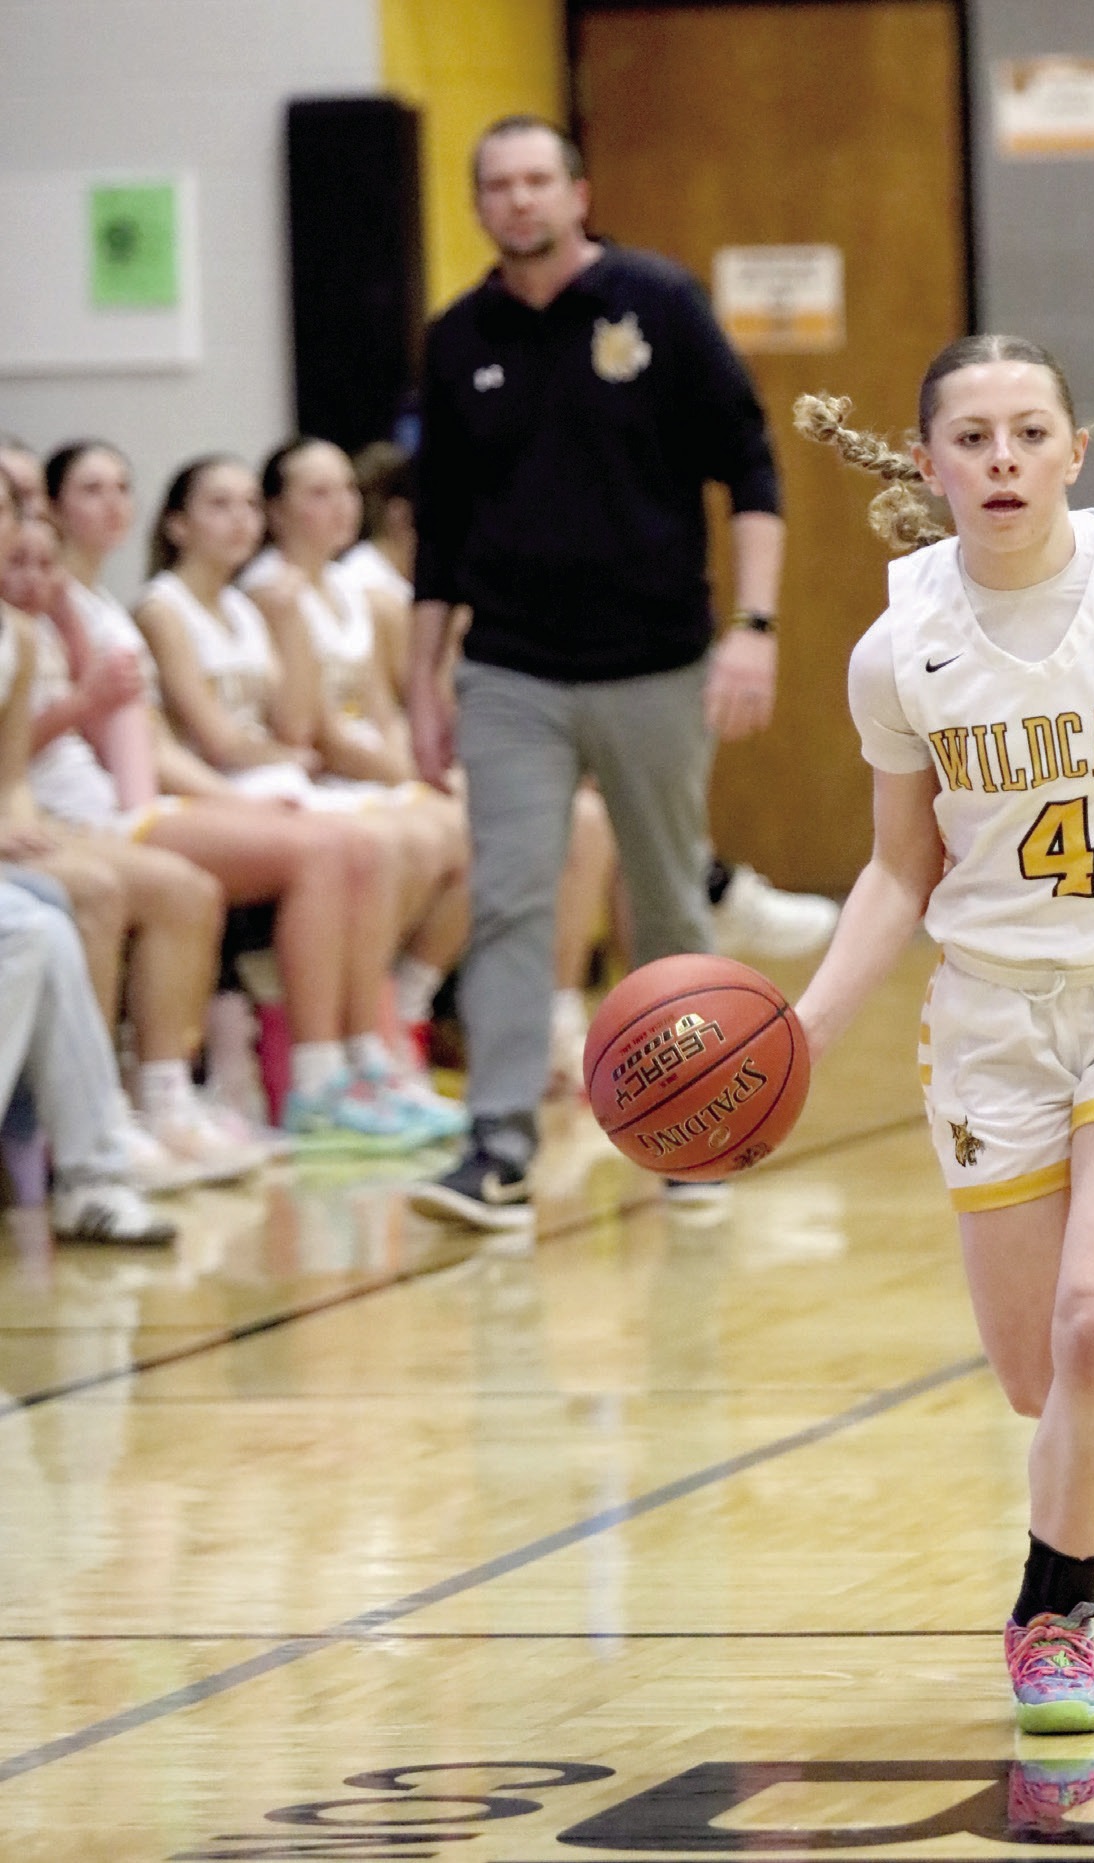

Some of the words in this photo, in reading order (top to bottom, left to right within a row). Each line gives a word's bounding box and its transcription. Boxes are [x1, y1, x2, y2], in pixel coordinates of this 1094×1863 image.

[612, 1027, 673, 1081] 1000
[614, 1020, 726, 1111] LEGACY
[636, 1055, 768, 1158] SPALDING
